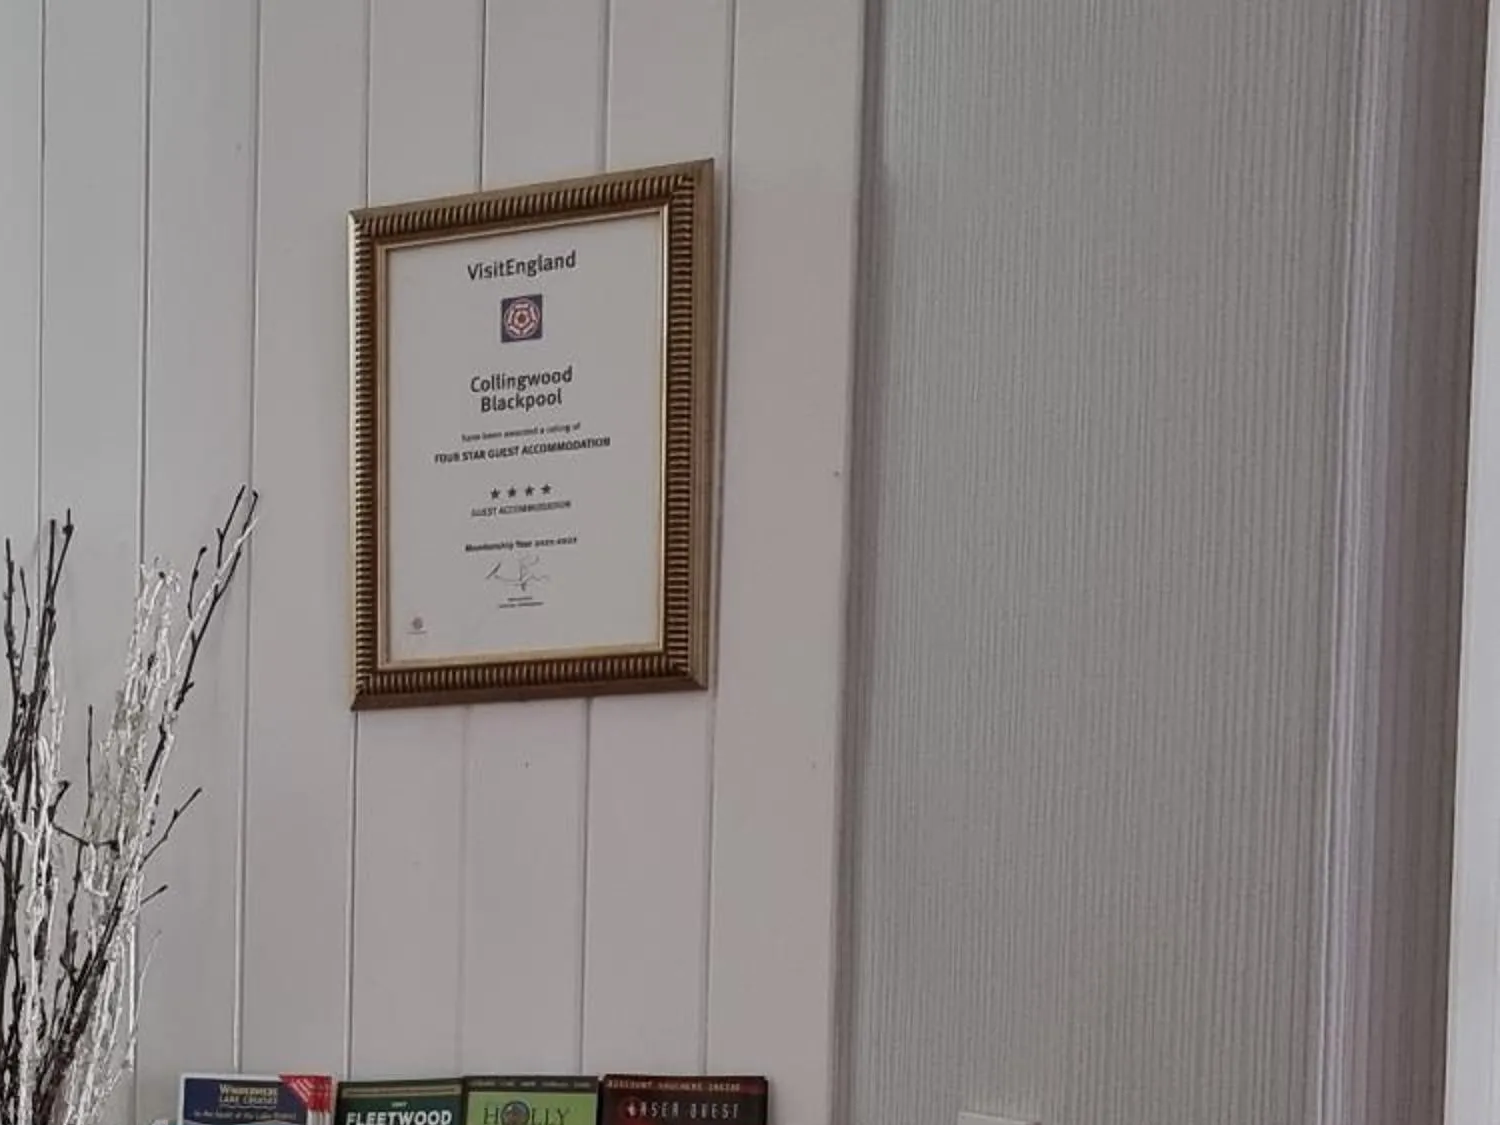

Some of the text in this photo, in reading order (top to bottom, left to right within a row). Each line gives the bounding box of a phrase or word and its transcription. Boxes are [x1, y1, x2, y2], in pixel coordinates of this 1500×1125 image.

[467, 250, 577, 281] VisitEngland
[470, 365, 573, 393] Collingwood
[480, 388, 563, 413] Blackpool
[434, 436, 611, 464] FOUR STAR GUEST ACCOMMODATION
[690, 1102, 740, 1120] QUEST
